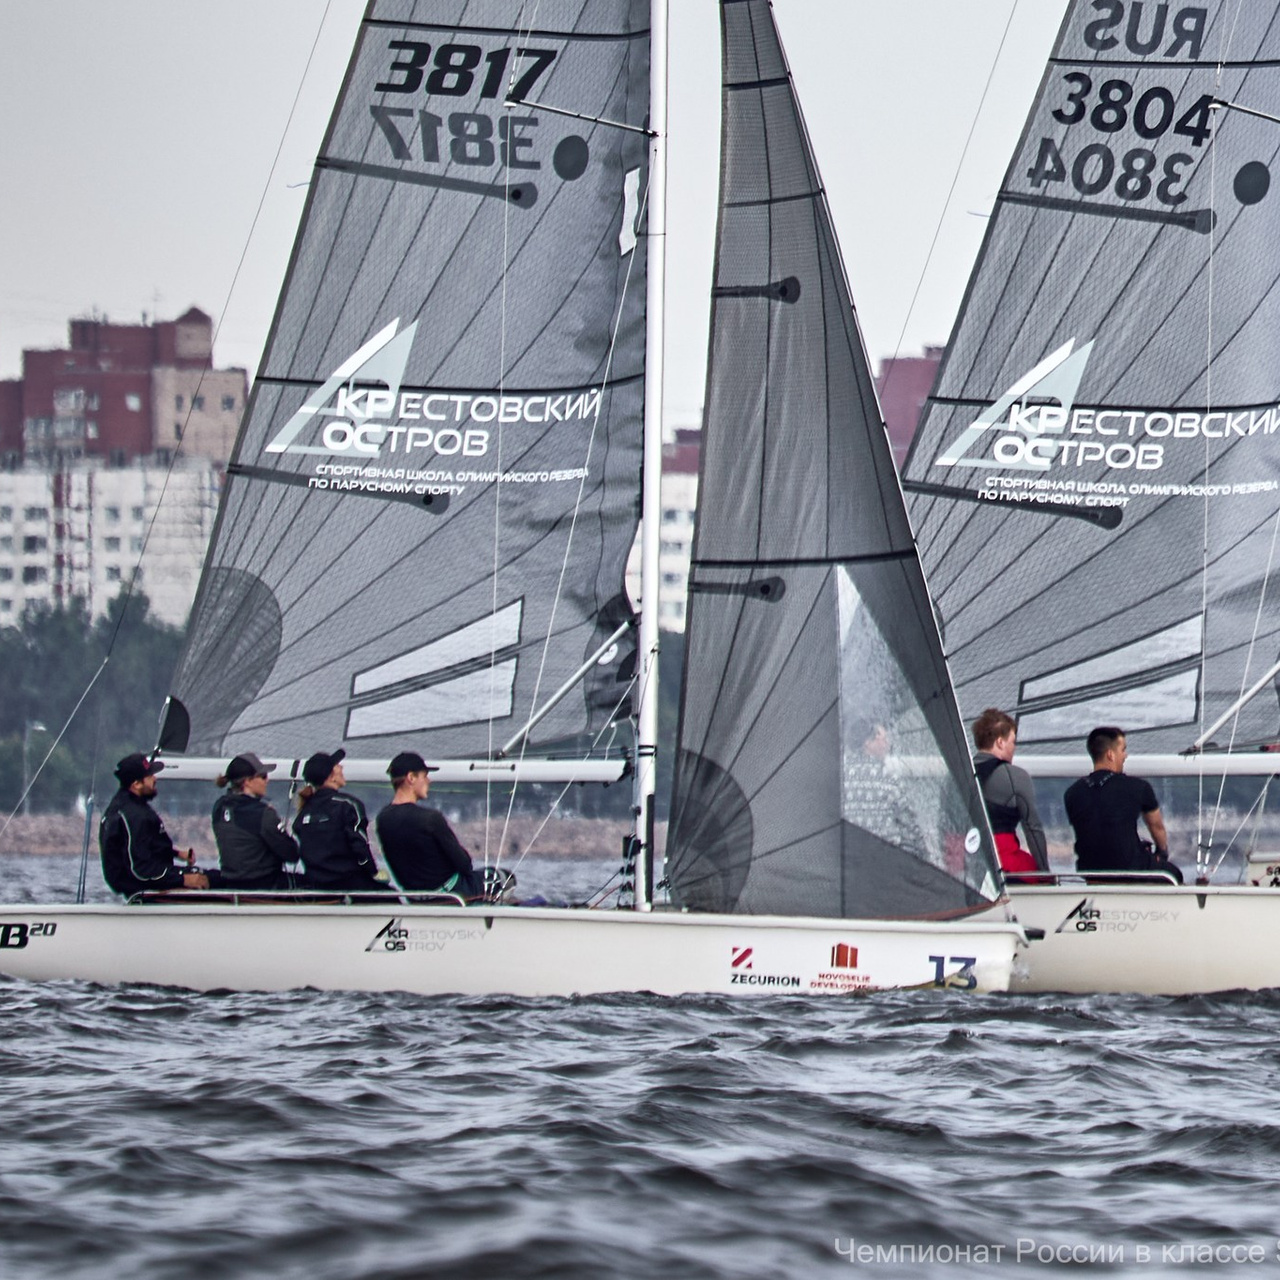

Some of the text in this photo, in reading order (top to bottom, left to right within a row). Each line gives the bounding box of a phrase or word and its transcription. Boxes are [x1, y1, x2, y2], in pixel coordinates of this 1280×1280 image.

[373, 40, 558, 100] 3817
[1051, 71, 1214, 147] 3804
[335, 387, 602, 423] КРЕСТОВСКИЙ
[322, 422, 490, 456] ОСТРОВ
[993, 436, 1164, 470] ОСТРОВ
[315, 464, 405, 480] СПОРТИВНАЯ
[406, 469, 453, 483] ШКОЛА
[308, 478, 466, 496] ПО ПАРУСНОМУ СПОРТУ
[985, 476, 1075, 492] СПОРТИВНАЯ
[1077, 481, 1126, 494] ШКОЛА
[977, 489, 998, 499] ПО
[999, 490, 1084, 506] ПАРУСНОМУ
[1079, 910, 1180, 921] KRESTOVSKY
[387, 928, 487, 940] KRESTOVSKY
[1076, 921, 1138, 932] OSTROV
[0, 923, 57, 949] B20
[384, 940, 446, 952] OSTROV
[731, 974, 801, 987] ZECURION
[928, 955, 978, 990] 13
